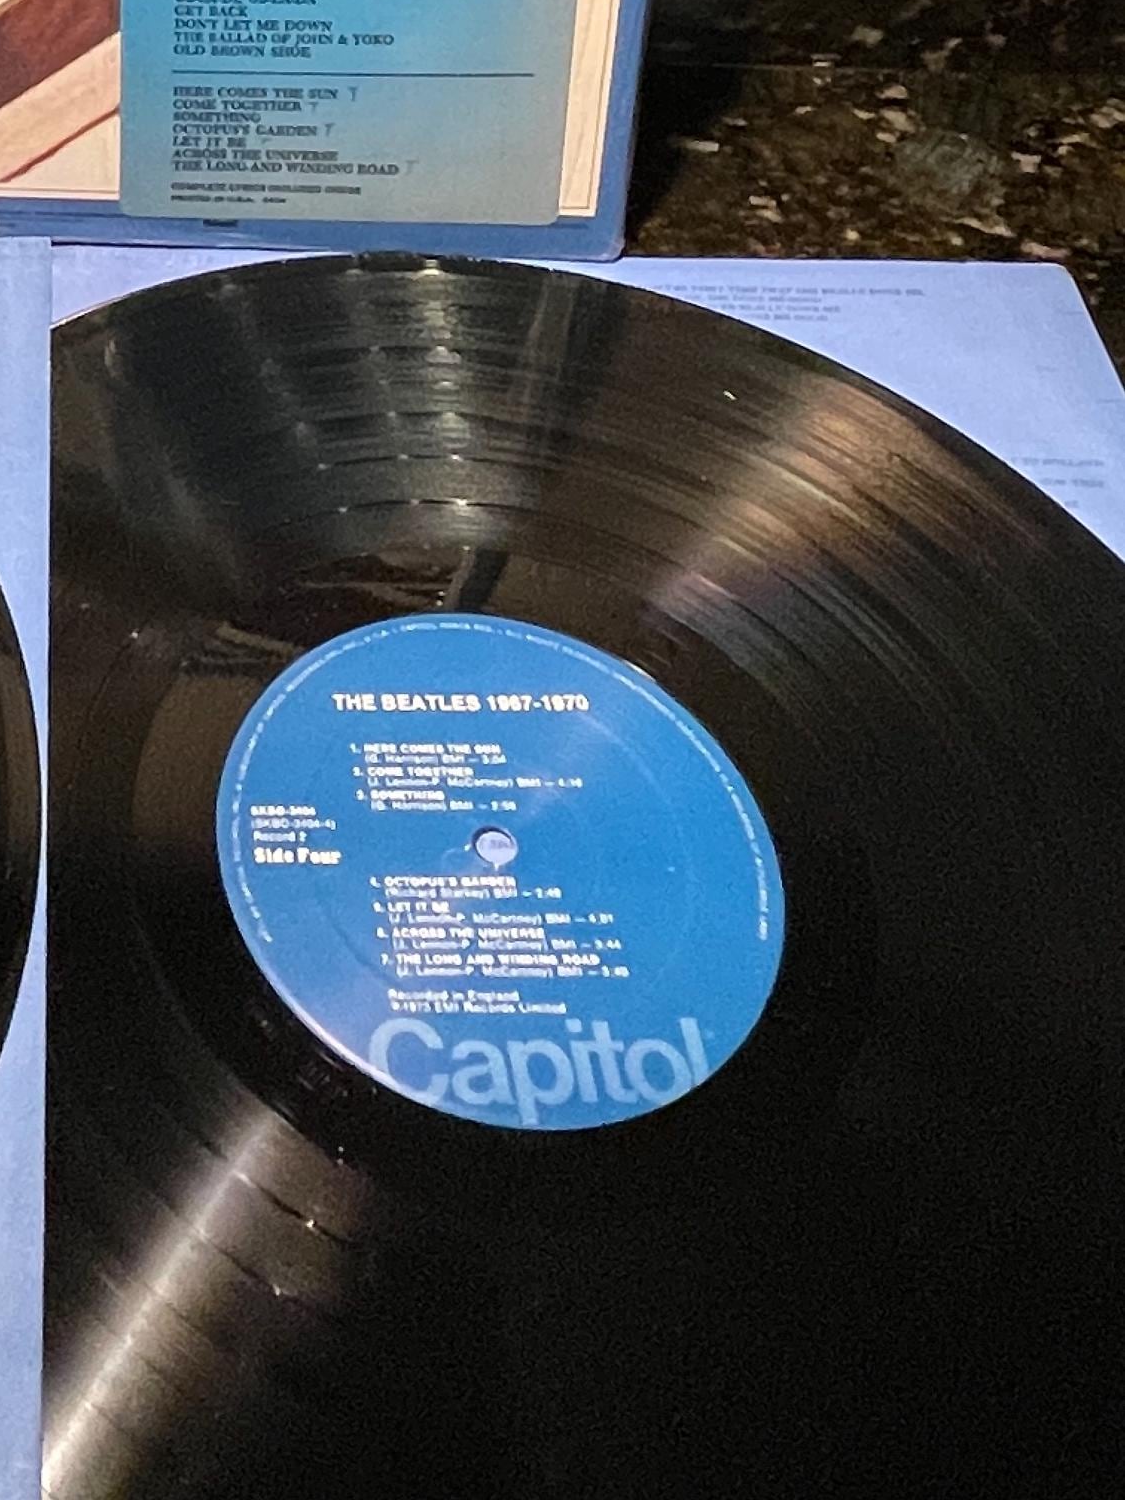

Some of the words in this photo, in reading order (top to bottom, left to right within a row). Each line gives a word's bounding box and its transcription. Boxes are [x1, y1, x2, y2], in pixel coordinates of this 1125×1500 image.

[173, 4, 203, 16] GET
[209, 4, 247, 17] BACK
[223, 19, 251, 31] LET
[257, 19, 279, 31] ME
[285, 19, 332, 32] DOWN
[173, 31, 204, 43] THE
[209, 32, 267, 44] BALLAD
[271, 32, 291, 44] OF
[295, 33, 333, 45] JOHN
[337, 33, 348, 45] &
[353, 33, 394, 46] YOKO
[173, 43, 205, 56] OLD
[211, 45, 264, 57] BROWN
[271, 45, 311, 58] SHOE
[173, 85, 214, 97] HERE
[217, 86, 267, 98] COMES
[273, 87, 303, 99] THE
[307, 87, 338, 99] SUN
[173, 98, 216, 110] COME
[221, 99, 301, 112] TOGETHER
[173, 111, 261, 123] SOMETHING
[255, 124, 317, 137] GARDEN
[173, 135, 200, 146] LET
[207, 136, 220, 147] IT
[227, 136, 246, 148] BE
[231, 148, 261, 161] THE
[172, 160, 203, 171] THE
[207, 161, 248, 171] LONG
[251, 161, 282, 173] AND
[287, 162, 353, 174] WINDING
[357, 163, 399, 175] ROAD
[333, 693, 375, 711] THE
[381, 693, 480, 711] BEATLES
[487, 693, 589, 711] 1967-1970
[254, 847, 295, 864] Side
[297, 847, 341, 865] Four
[369, 1017, 709, 1125] Capitol
